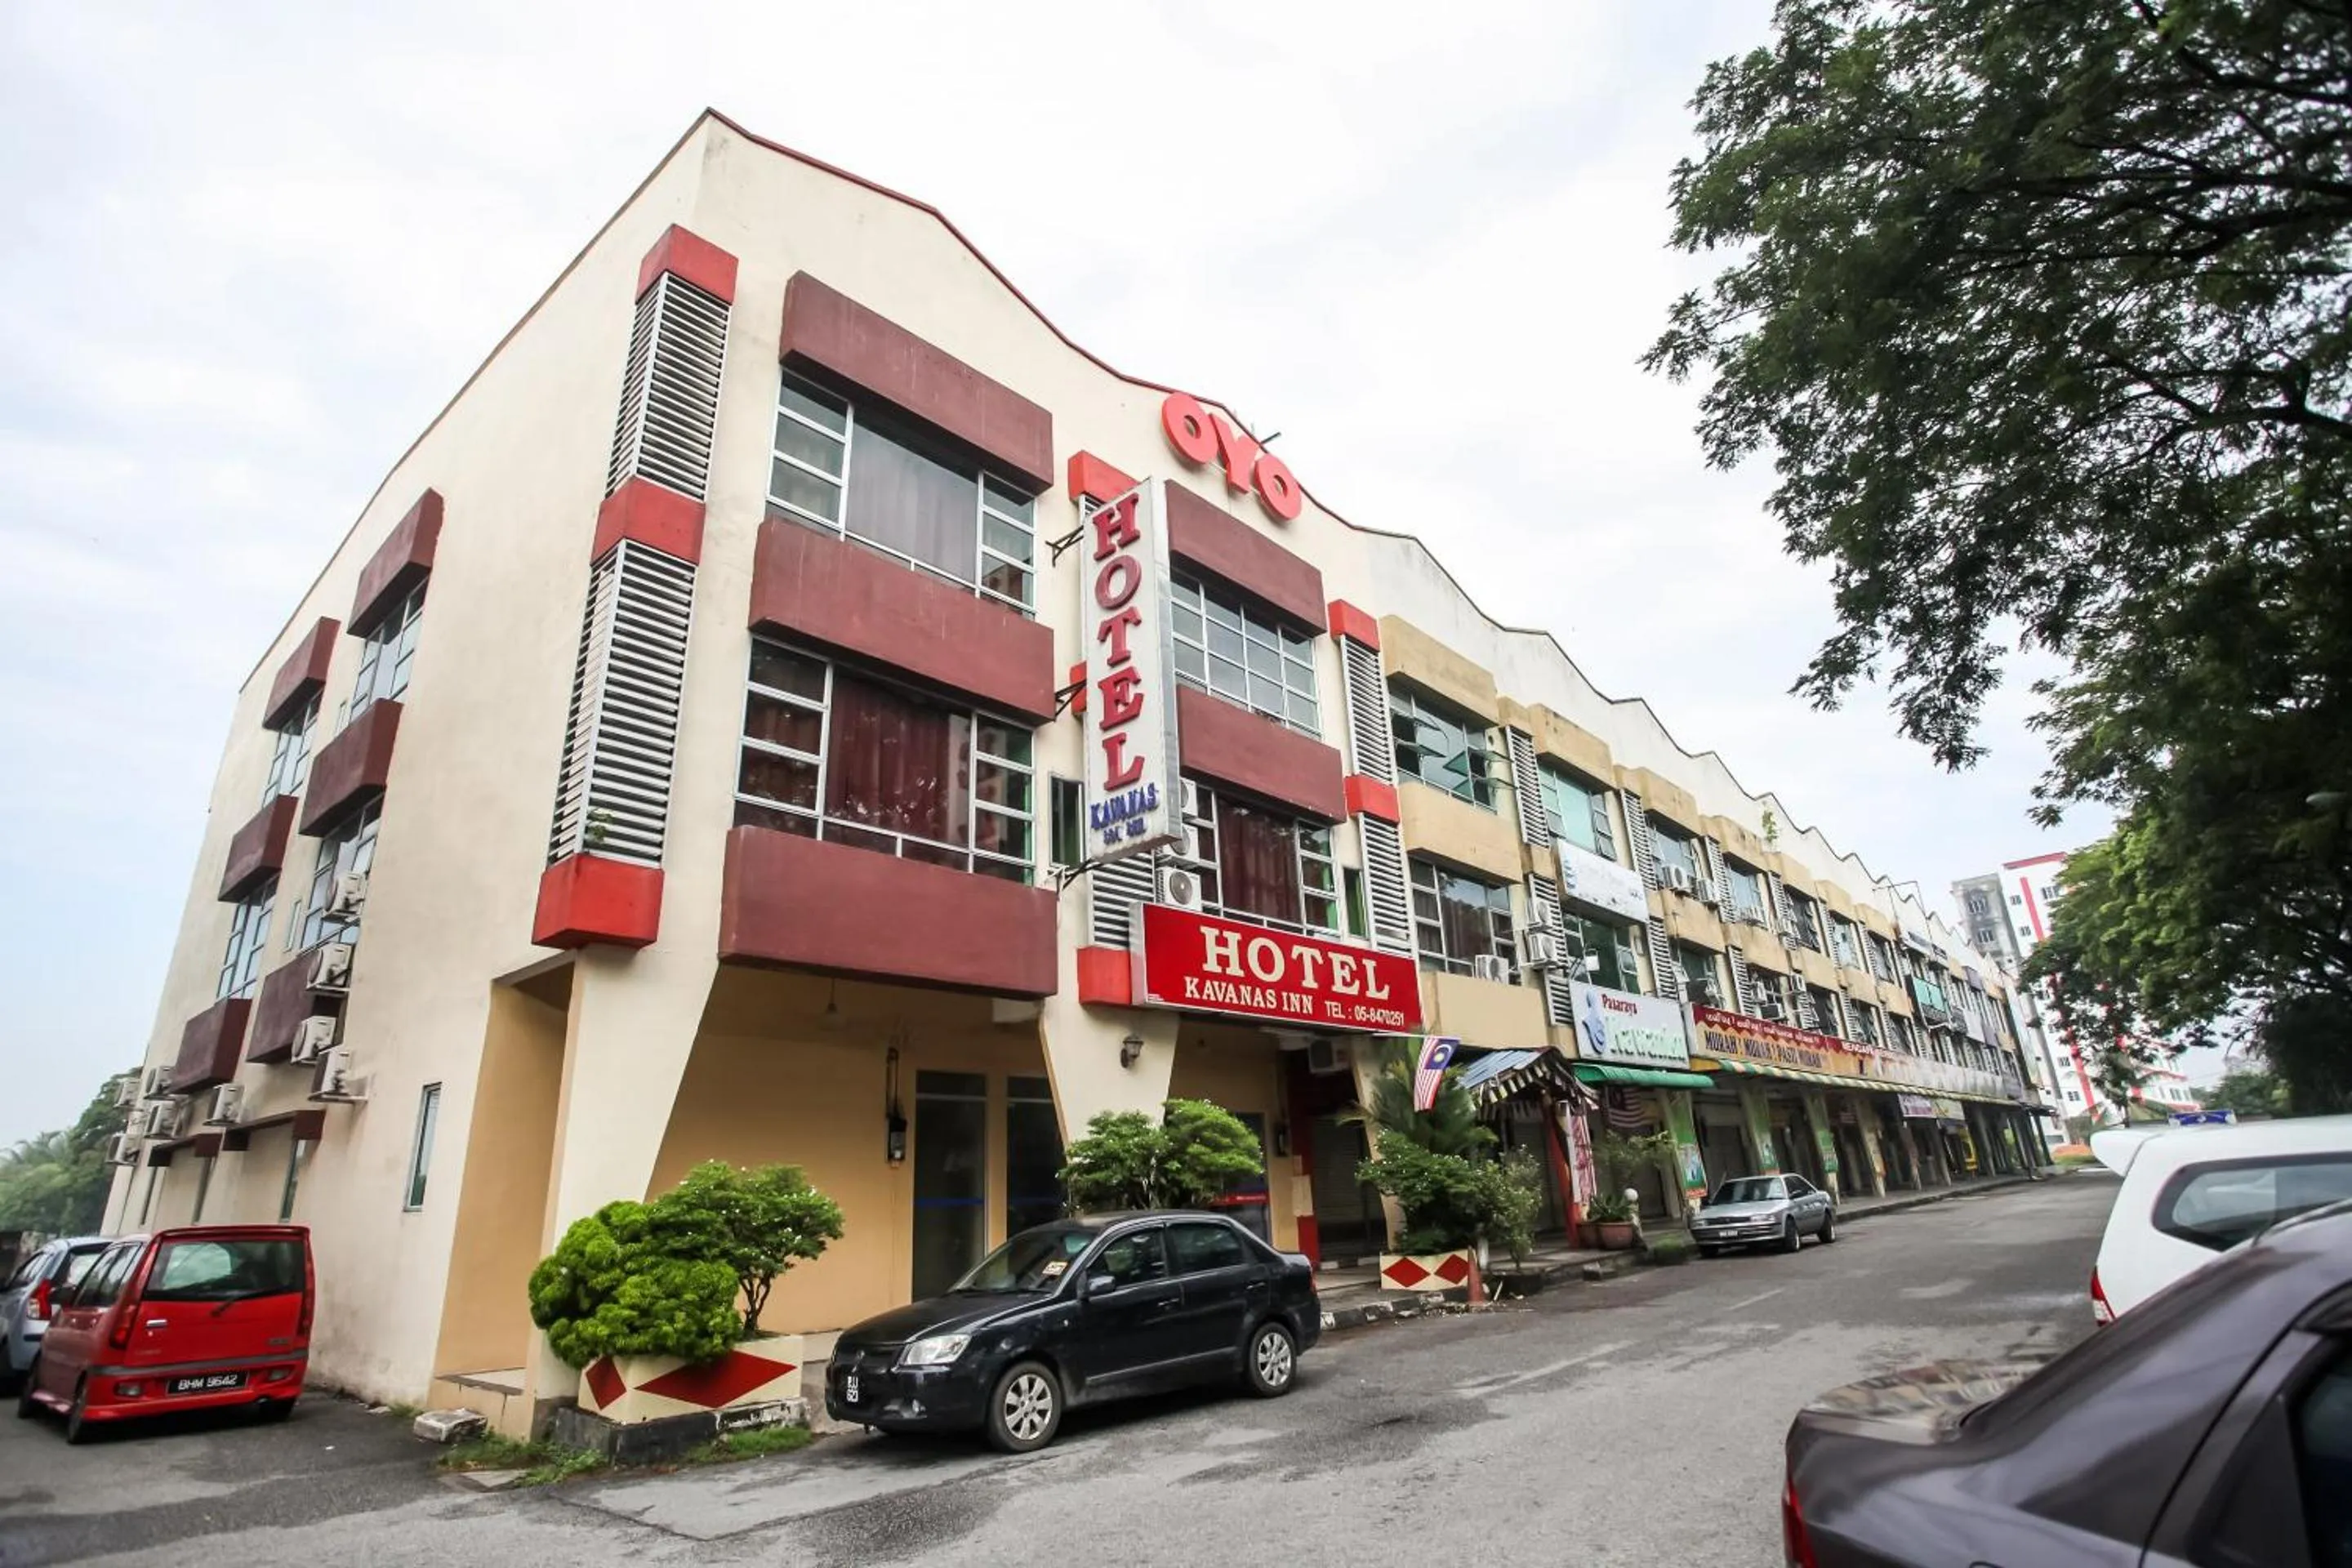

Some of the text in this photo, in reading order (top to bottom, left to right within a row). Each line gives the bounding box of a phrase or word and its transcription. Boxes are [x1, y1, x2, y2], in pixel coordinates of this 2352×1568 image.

[1162, 392, 1303, 521] OYO
[1093, 492, 1145, 791] HOTEL
[1184, 976, 1277, 1009] KAVANAS
[1282, 992, 1313, 1014] INN
[1200, 925, 1390, 1000] HOTEL
